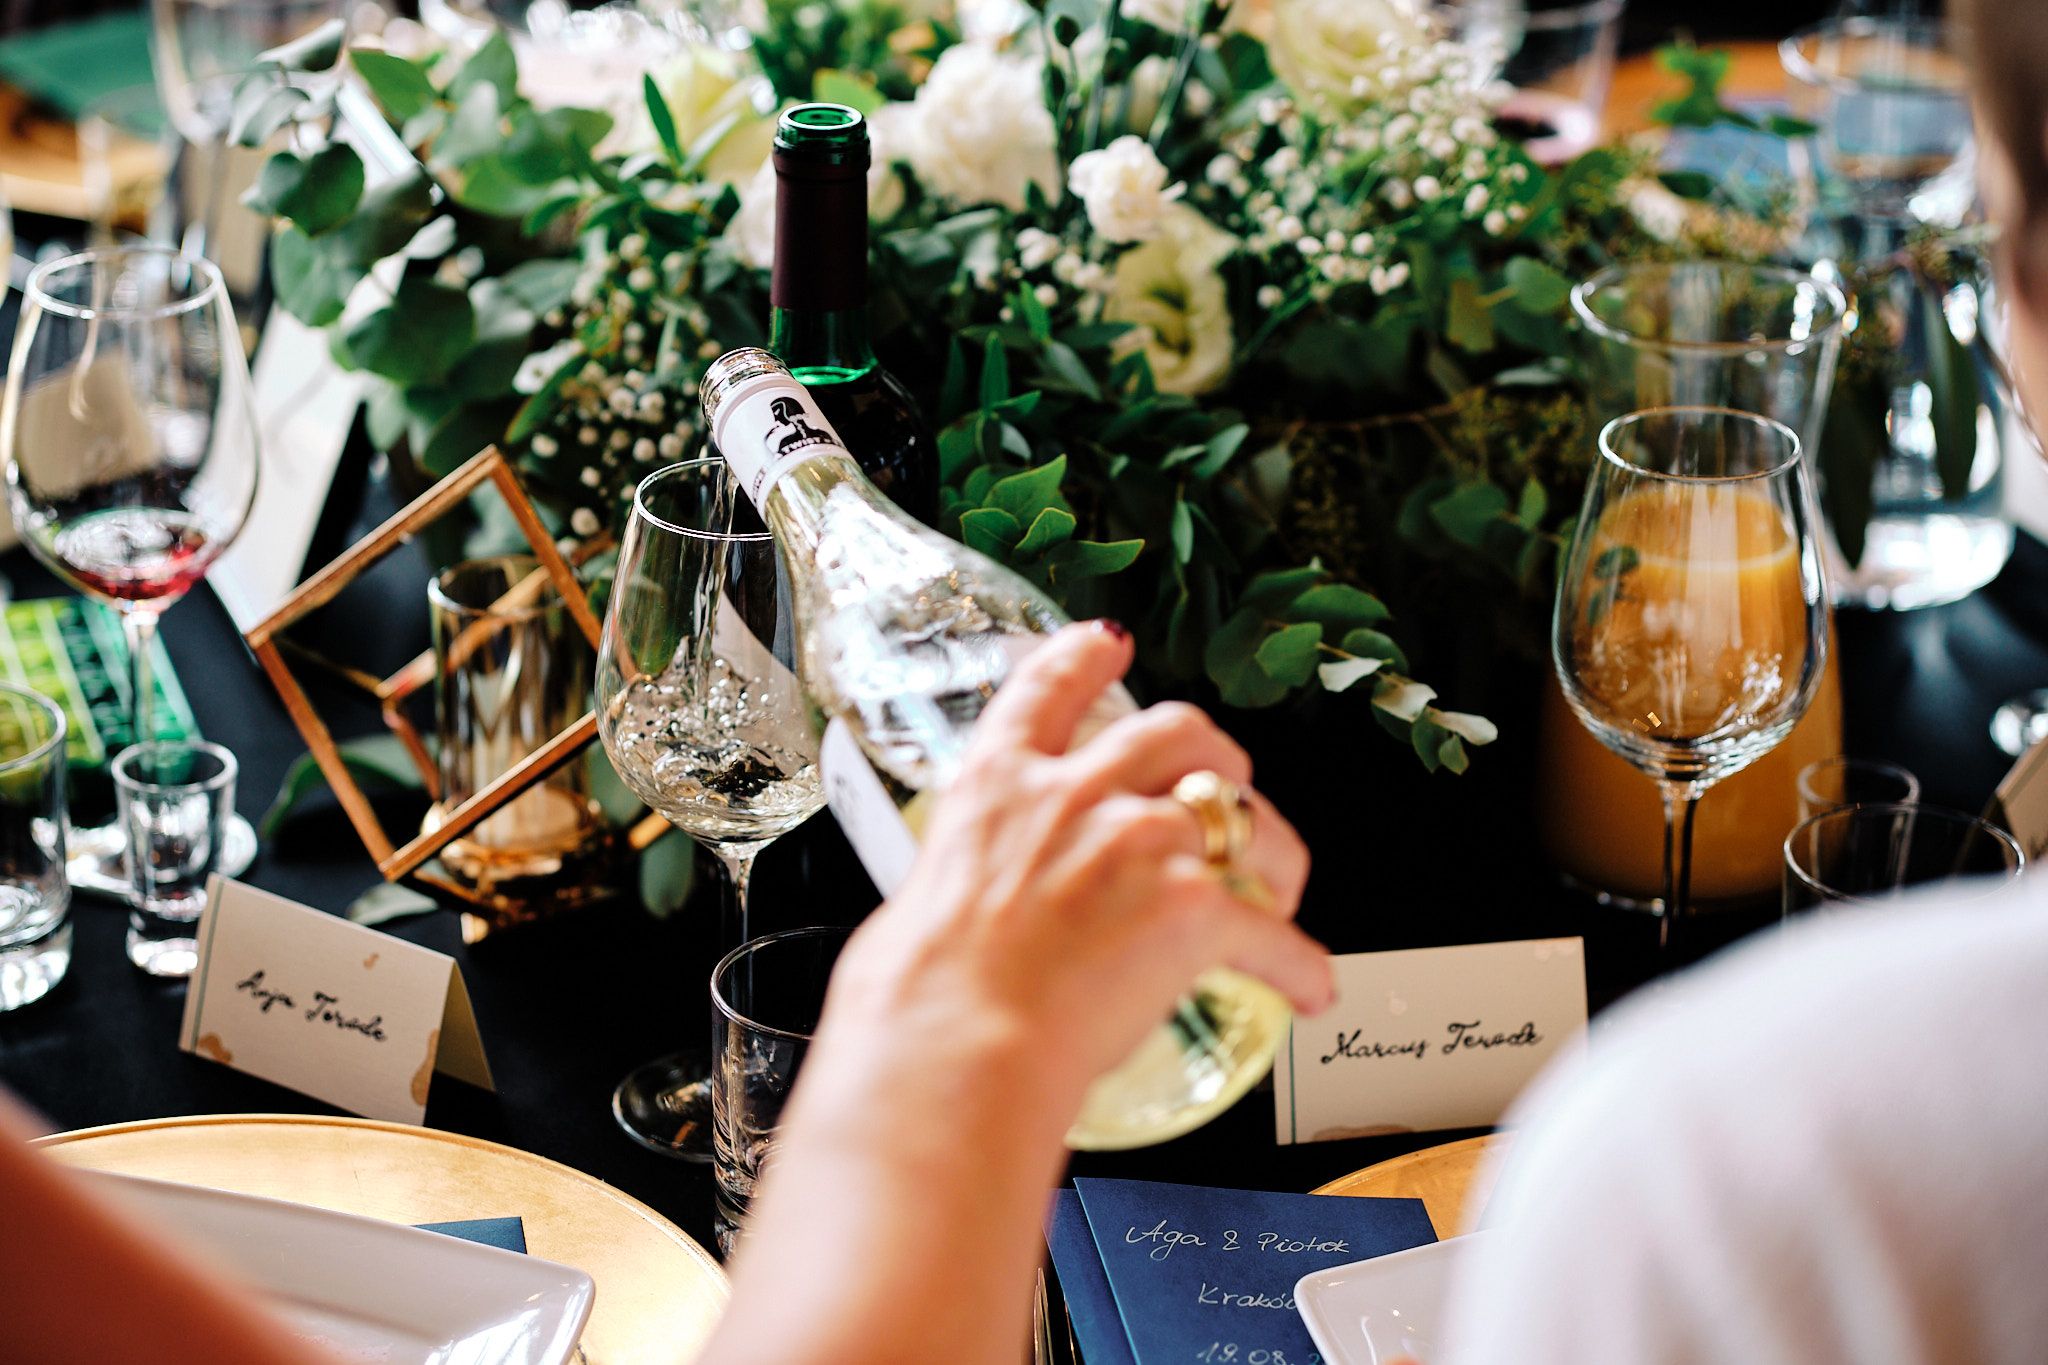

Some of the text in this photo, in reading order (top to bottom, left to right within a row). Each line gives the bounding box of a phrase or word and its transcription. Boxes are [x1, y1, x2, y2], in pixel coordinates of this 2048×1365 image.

[1320, 1028, 1430, 1064] Marcus
[1125, 1219, 1206, 1261] Aga
[1258, 1232, 1350, 1254] Piotrek
